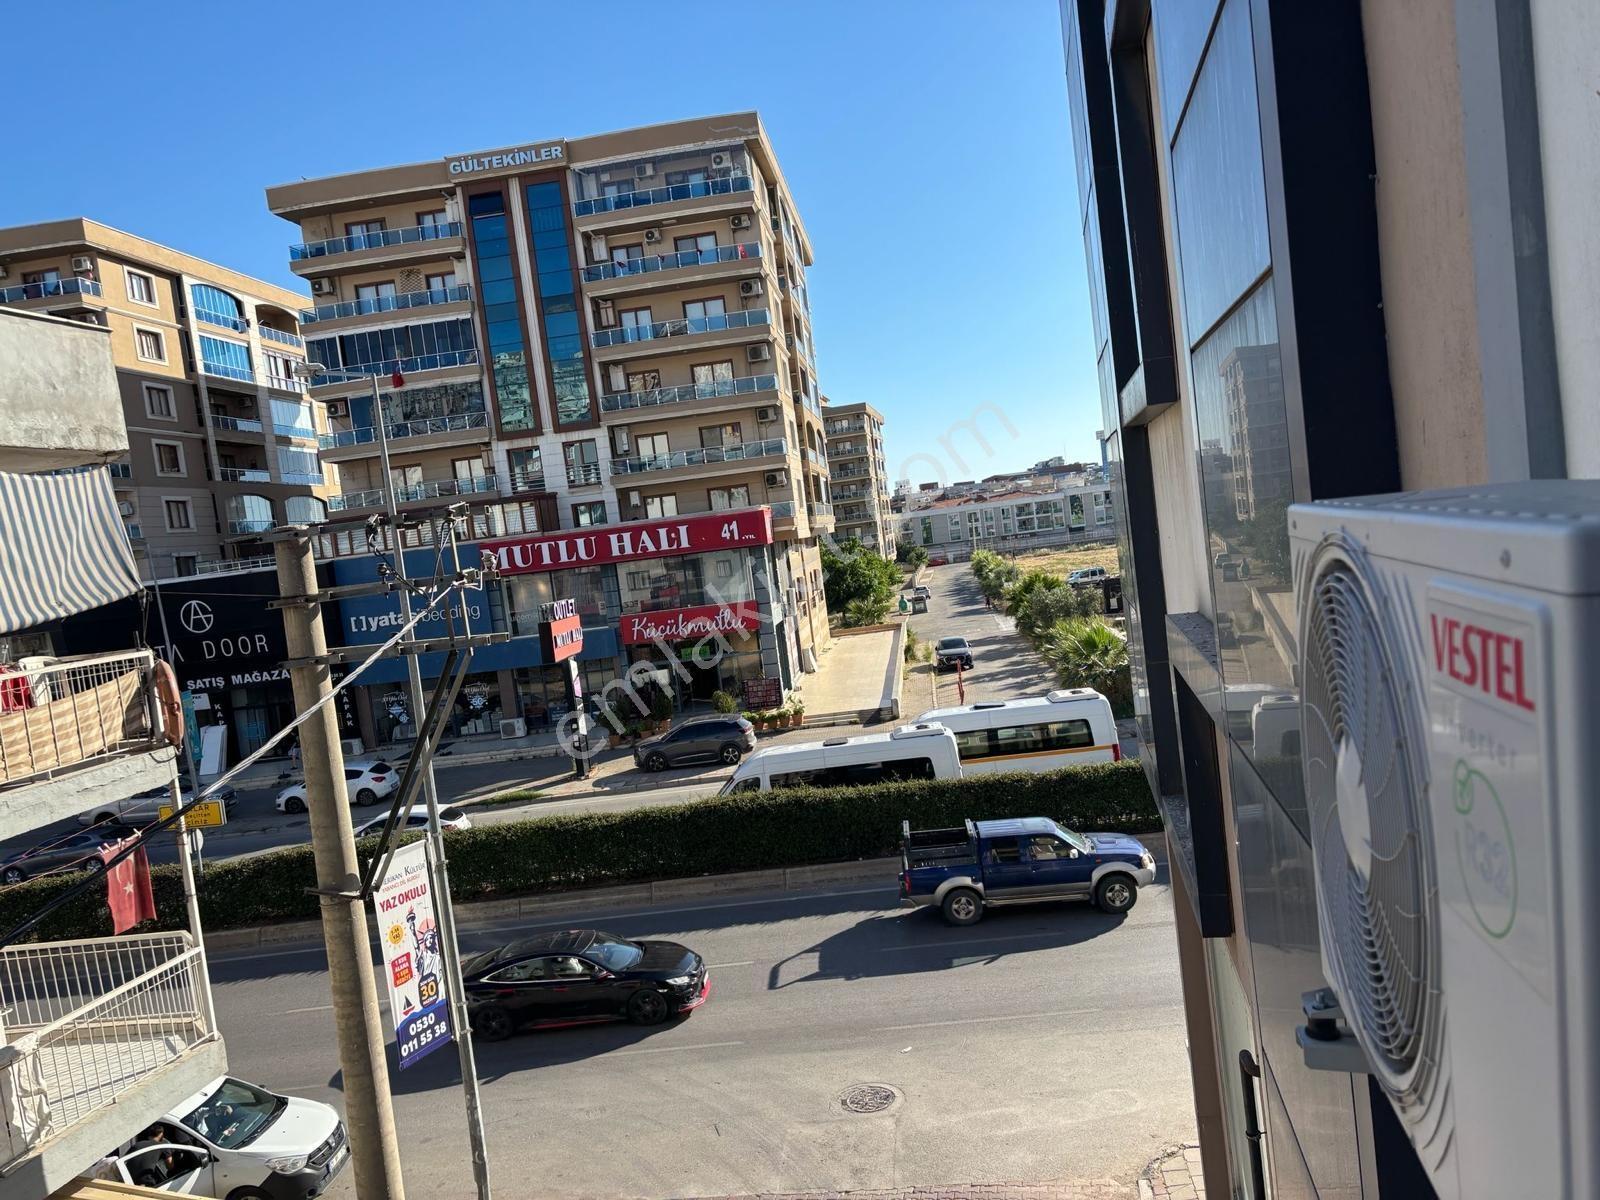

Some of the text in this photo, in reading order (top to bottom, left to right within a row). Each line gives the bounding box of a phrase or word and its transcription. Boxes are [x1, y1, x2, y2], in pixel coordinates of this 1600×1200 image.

[449, 146, 563, 174] GÜLTEKİNLER
[721, 520, 739, 541] 41
[480, 525, 692, 571] MUTLU HALI
[632, 608, 747, 641] Küçükmutlu
[202, 634, 269, 660] DOOR
[1430, 613, 1536, 712] VESTEL
[186, 669, 291, 690] SATIŞ MAĞAZA
[379, 883, 427, 913] YAZ OKULU
[420, 981, 436, 1000] 30
[409, 1012, 435, 1036] 0530
[401, 1021, 447, 1057] 011 55 38
